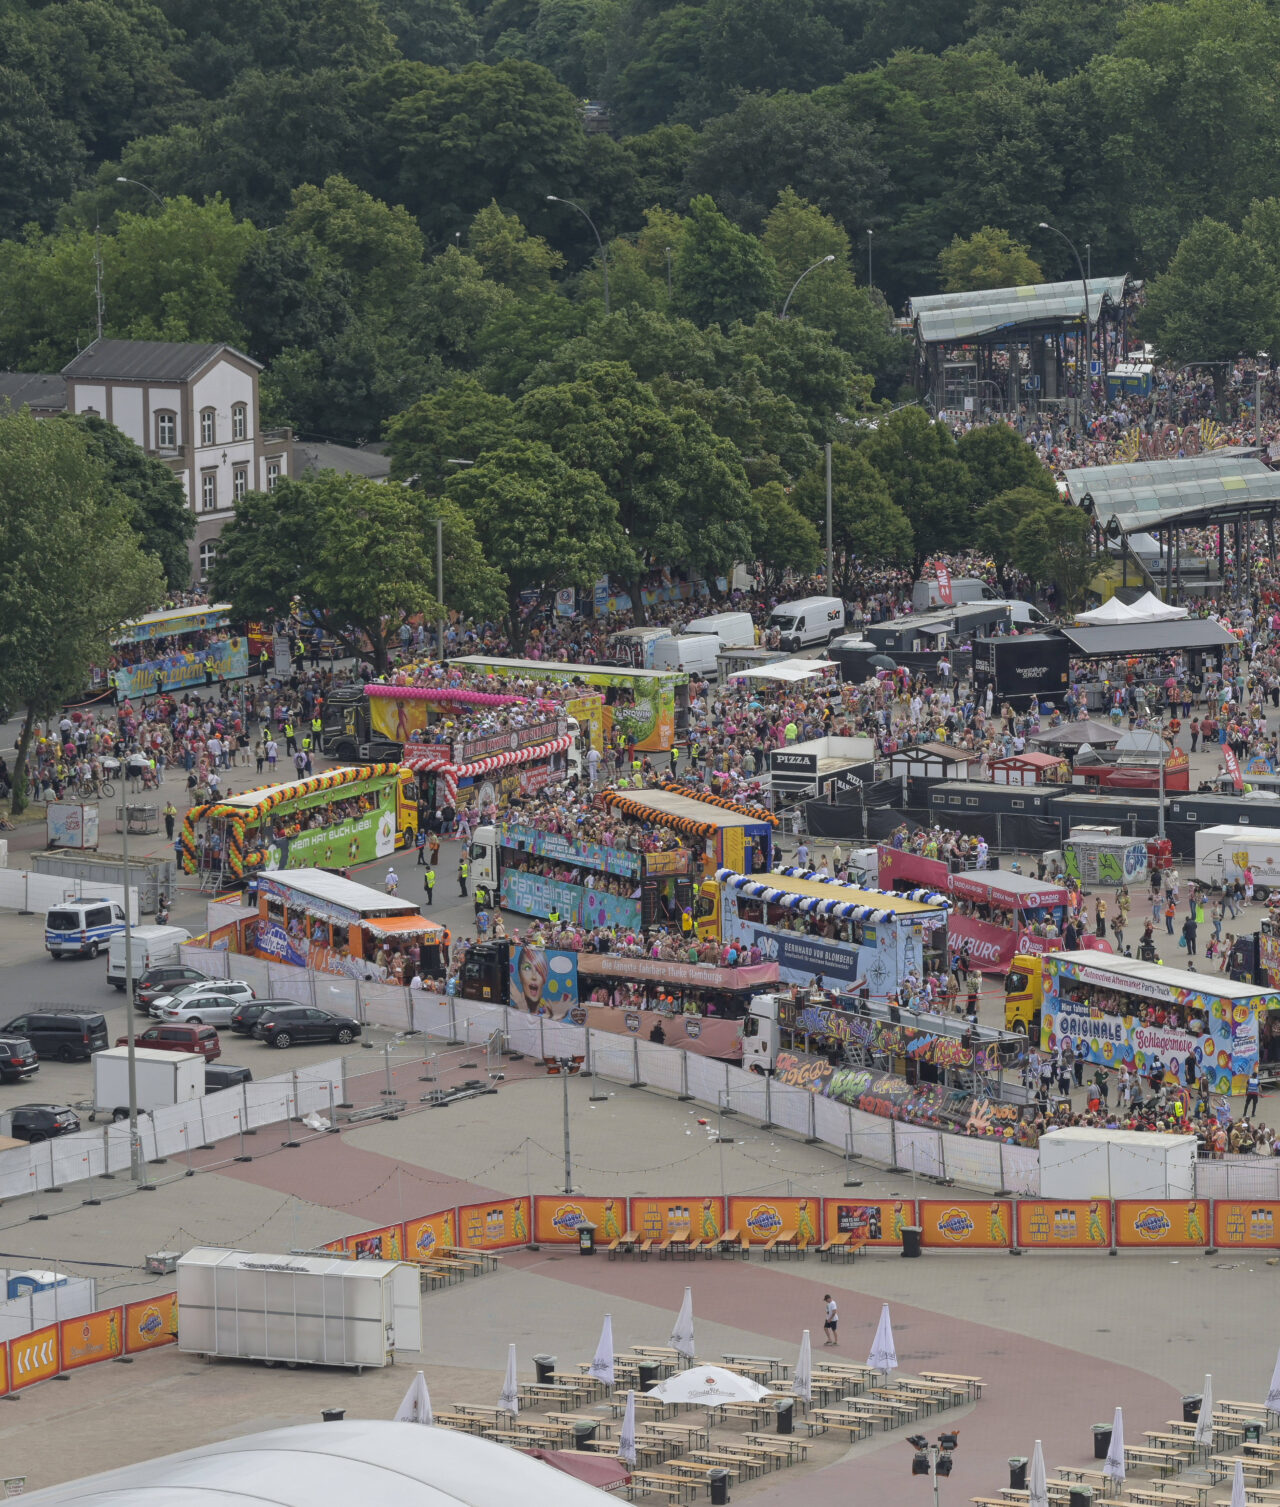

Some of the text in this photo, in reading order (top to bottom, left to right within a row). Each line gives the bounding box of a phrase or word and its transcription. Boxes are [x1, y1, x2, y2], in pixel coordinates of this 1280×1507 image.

[776, 755, 811, 765] PIZZA
[847, 773, 863, 787] PIZZA
[291, 819, 372, 850] HEM HAT EUCH LIEB!
[510, 873, 577, 905] danceliner
[784, 942, 853, 965] BERNHARD VON BLOMBERG
[947, 931, 1001, 960] AMBURG
[601, 958, 611, 968] Die
[639, 962, 666, 976] fahrbare
[667, 965, 687, 978] Theke
[689, 968, 722, 983] Hamburgs
[1084, 969, 1170, 997] Automotive Aftermarket Party-Truck
[1061, 1017, 1121, 1041] ORIGINALE
[1135, 1029, 1192, 1056] Schlagermove
[938, 1217, 967, 1230] Schlager
[1135, 1215, 1164, 1229] Schlager
